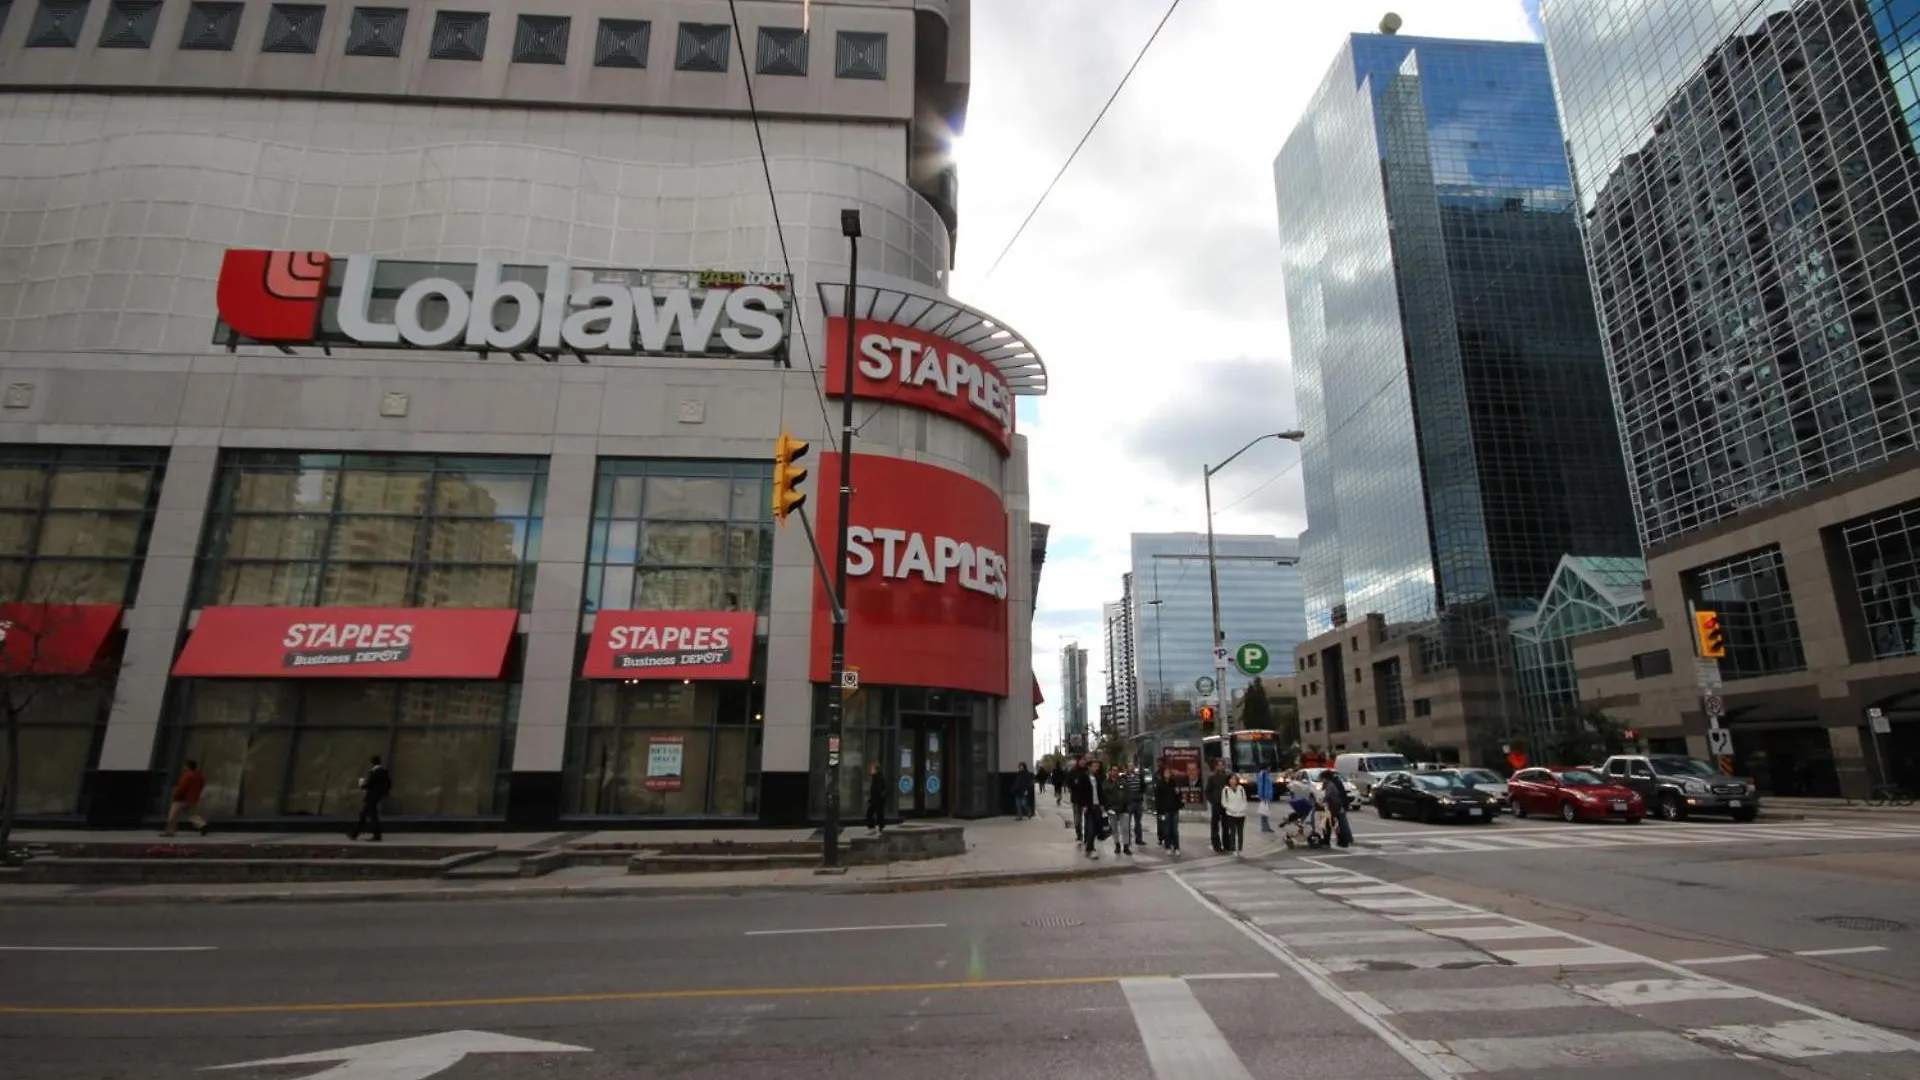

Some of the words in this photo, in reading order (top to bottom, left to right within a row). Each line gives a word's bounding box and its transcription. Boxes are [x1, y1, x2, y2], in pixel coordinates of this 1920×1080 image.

[337, 253, 784, 353] Loblaws
[858, 334, 1011, 430] STAPLES
[846, 525, 1008, 600] STAPLES
[283, 623, 413, 648] STAPLES
[608, 626, 730, 650] STAPLES
[293, 655, 351, 666] Business
[355, 650, 402, 662] DEPOT
[622, 656, 676, 667] Business
[680, 652, 723, 664] DEPOT
[1244, 648, 1262, 665] P
